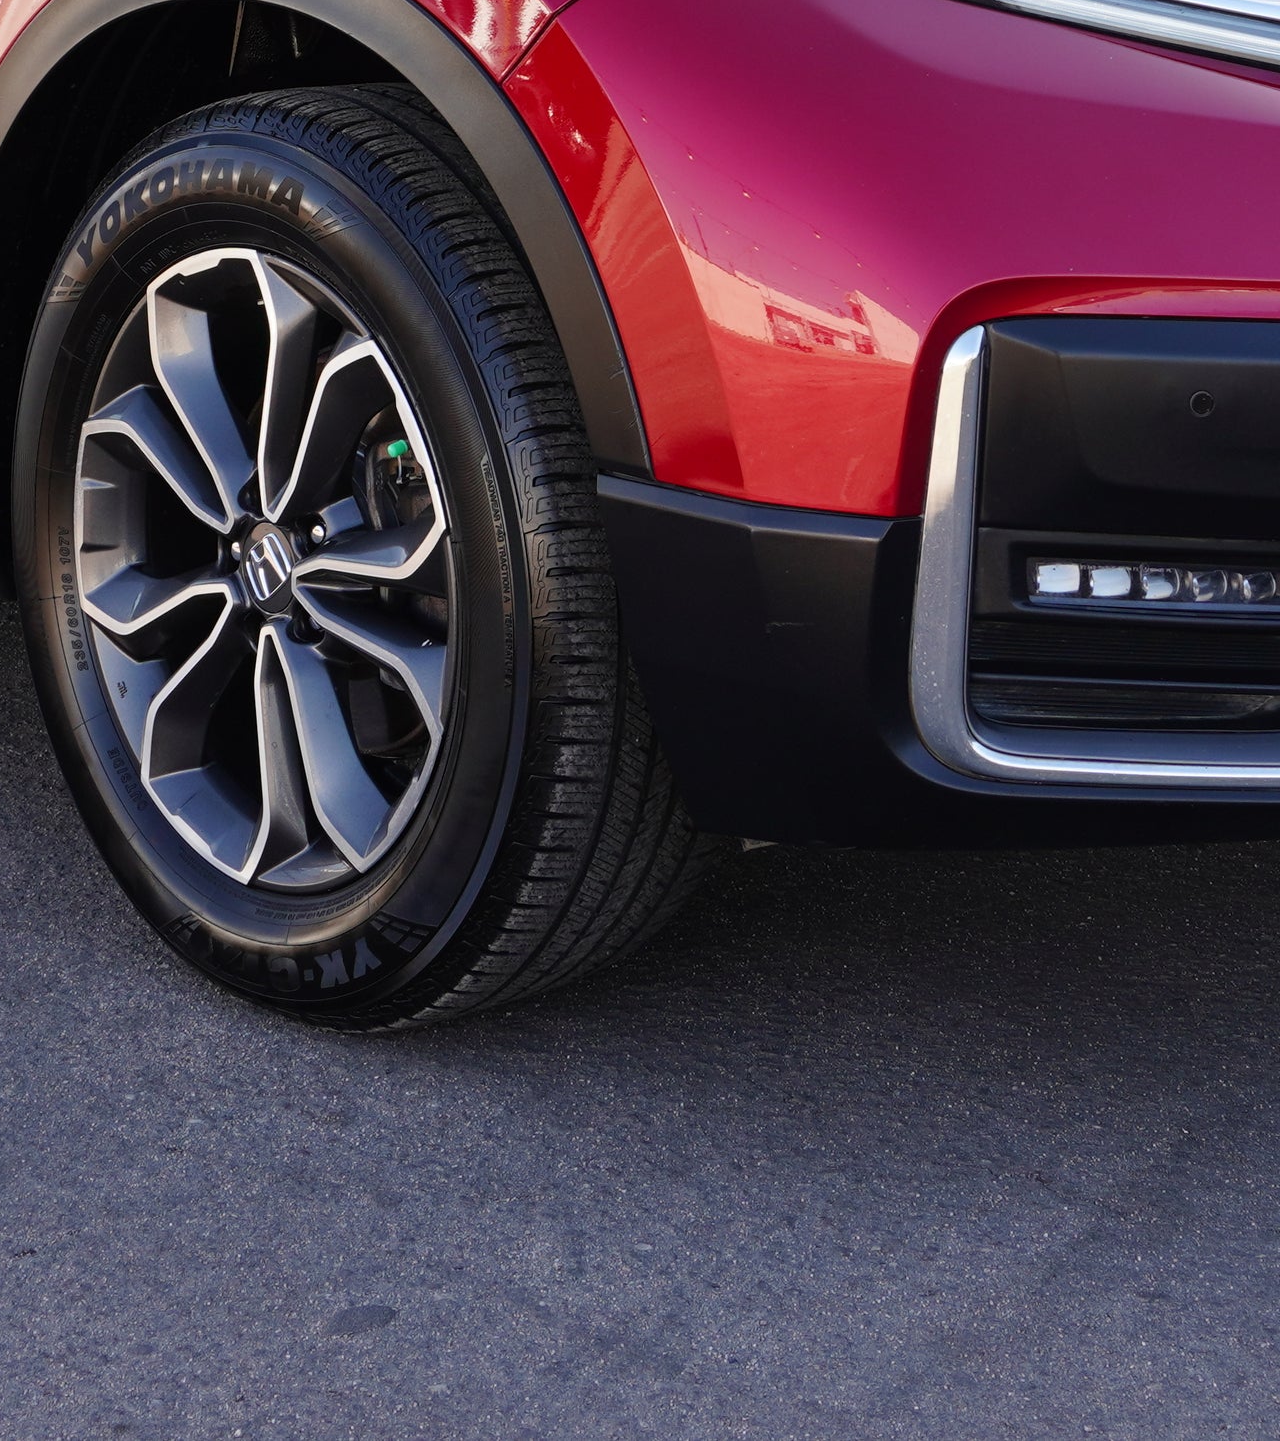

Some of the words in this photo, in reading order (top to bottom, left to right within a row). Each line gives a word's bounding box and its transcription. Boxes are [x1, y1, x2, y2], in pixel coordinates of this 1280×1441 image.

[75, 156, 305, 270] YOKOHAMA
[482, 460, 502, 522] TREADWEAR
[495, 523, 506, 542] 740
[498, 544, 511, 594] TRACTION
[503, 595, 511, 604] A
[107, 746, 150, 809] OUTSIDE
